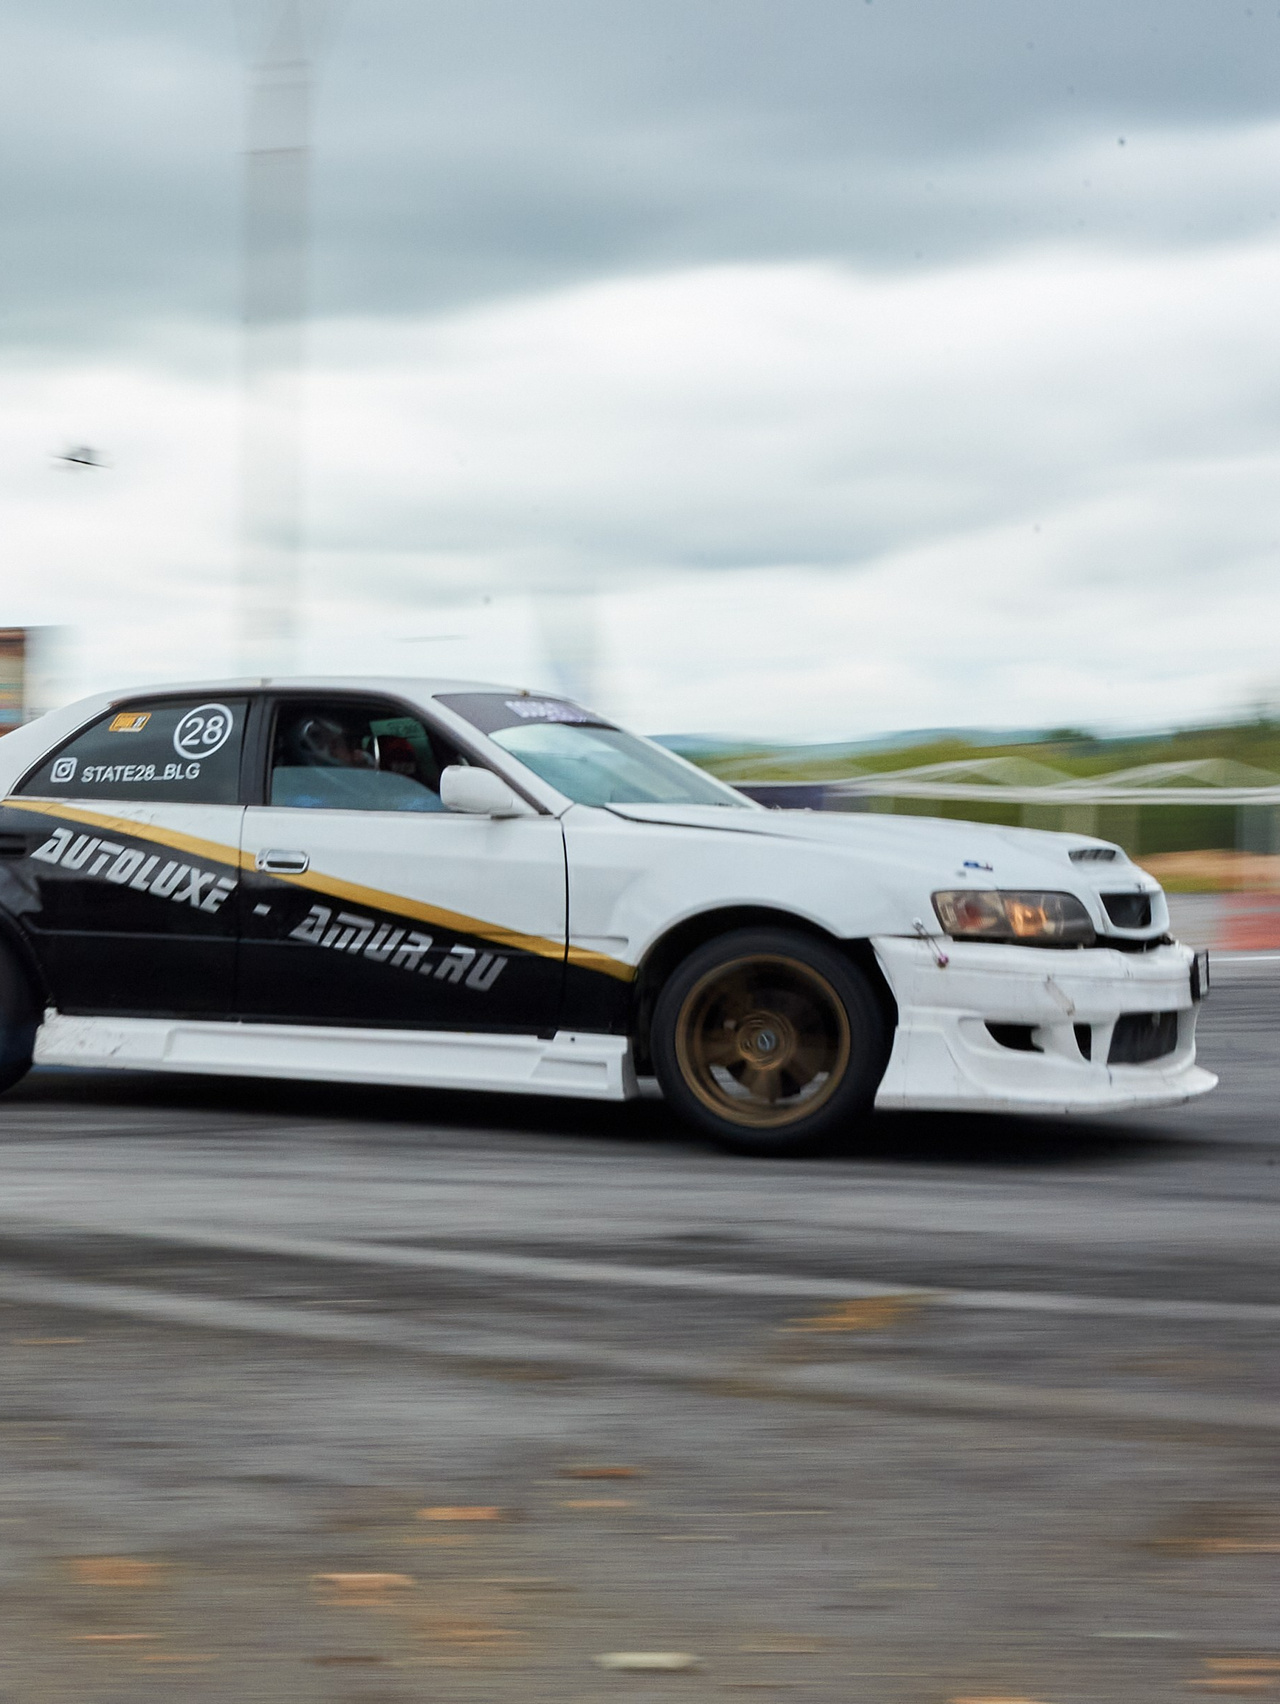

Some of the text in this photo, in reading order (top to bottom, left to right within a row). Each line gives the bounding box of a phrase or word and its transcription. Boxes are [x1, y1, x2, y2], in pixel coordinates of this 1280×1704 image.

[181, 716, 226, 746] 28
[81, 763, 201, 783] STATE28_BLG
[29, 827, 239, 914] AUTOLUXE
[288, 904, 509, 992] AMUR.RU
